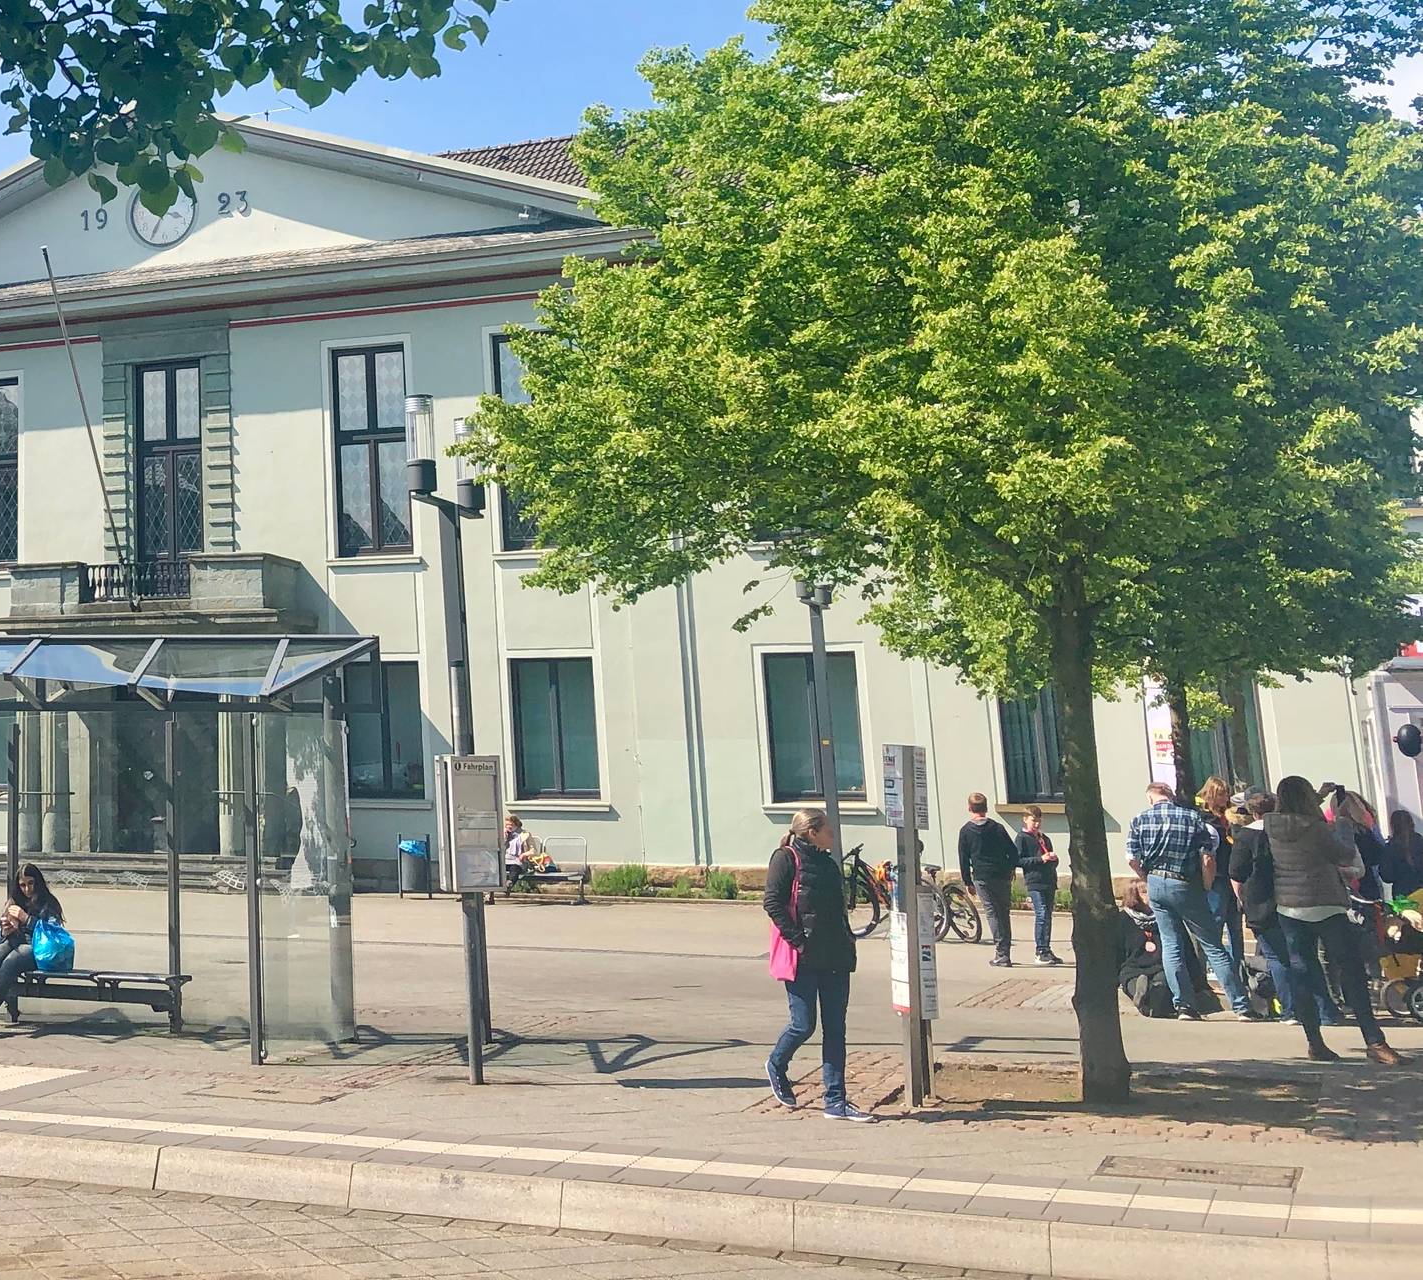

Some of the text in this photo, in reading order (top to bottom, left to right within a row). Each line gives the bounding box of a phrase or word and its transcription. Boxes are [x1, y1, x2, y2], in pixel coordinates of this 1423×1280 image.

[80, 190, 248, 231] 19 23
[463, 762, 494, 771] Fahrplan
